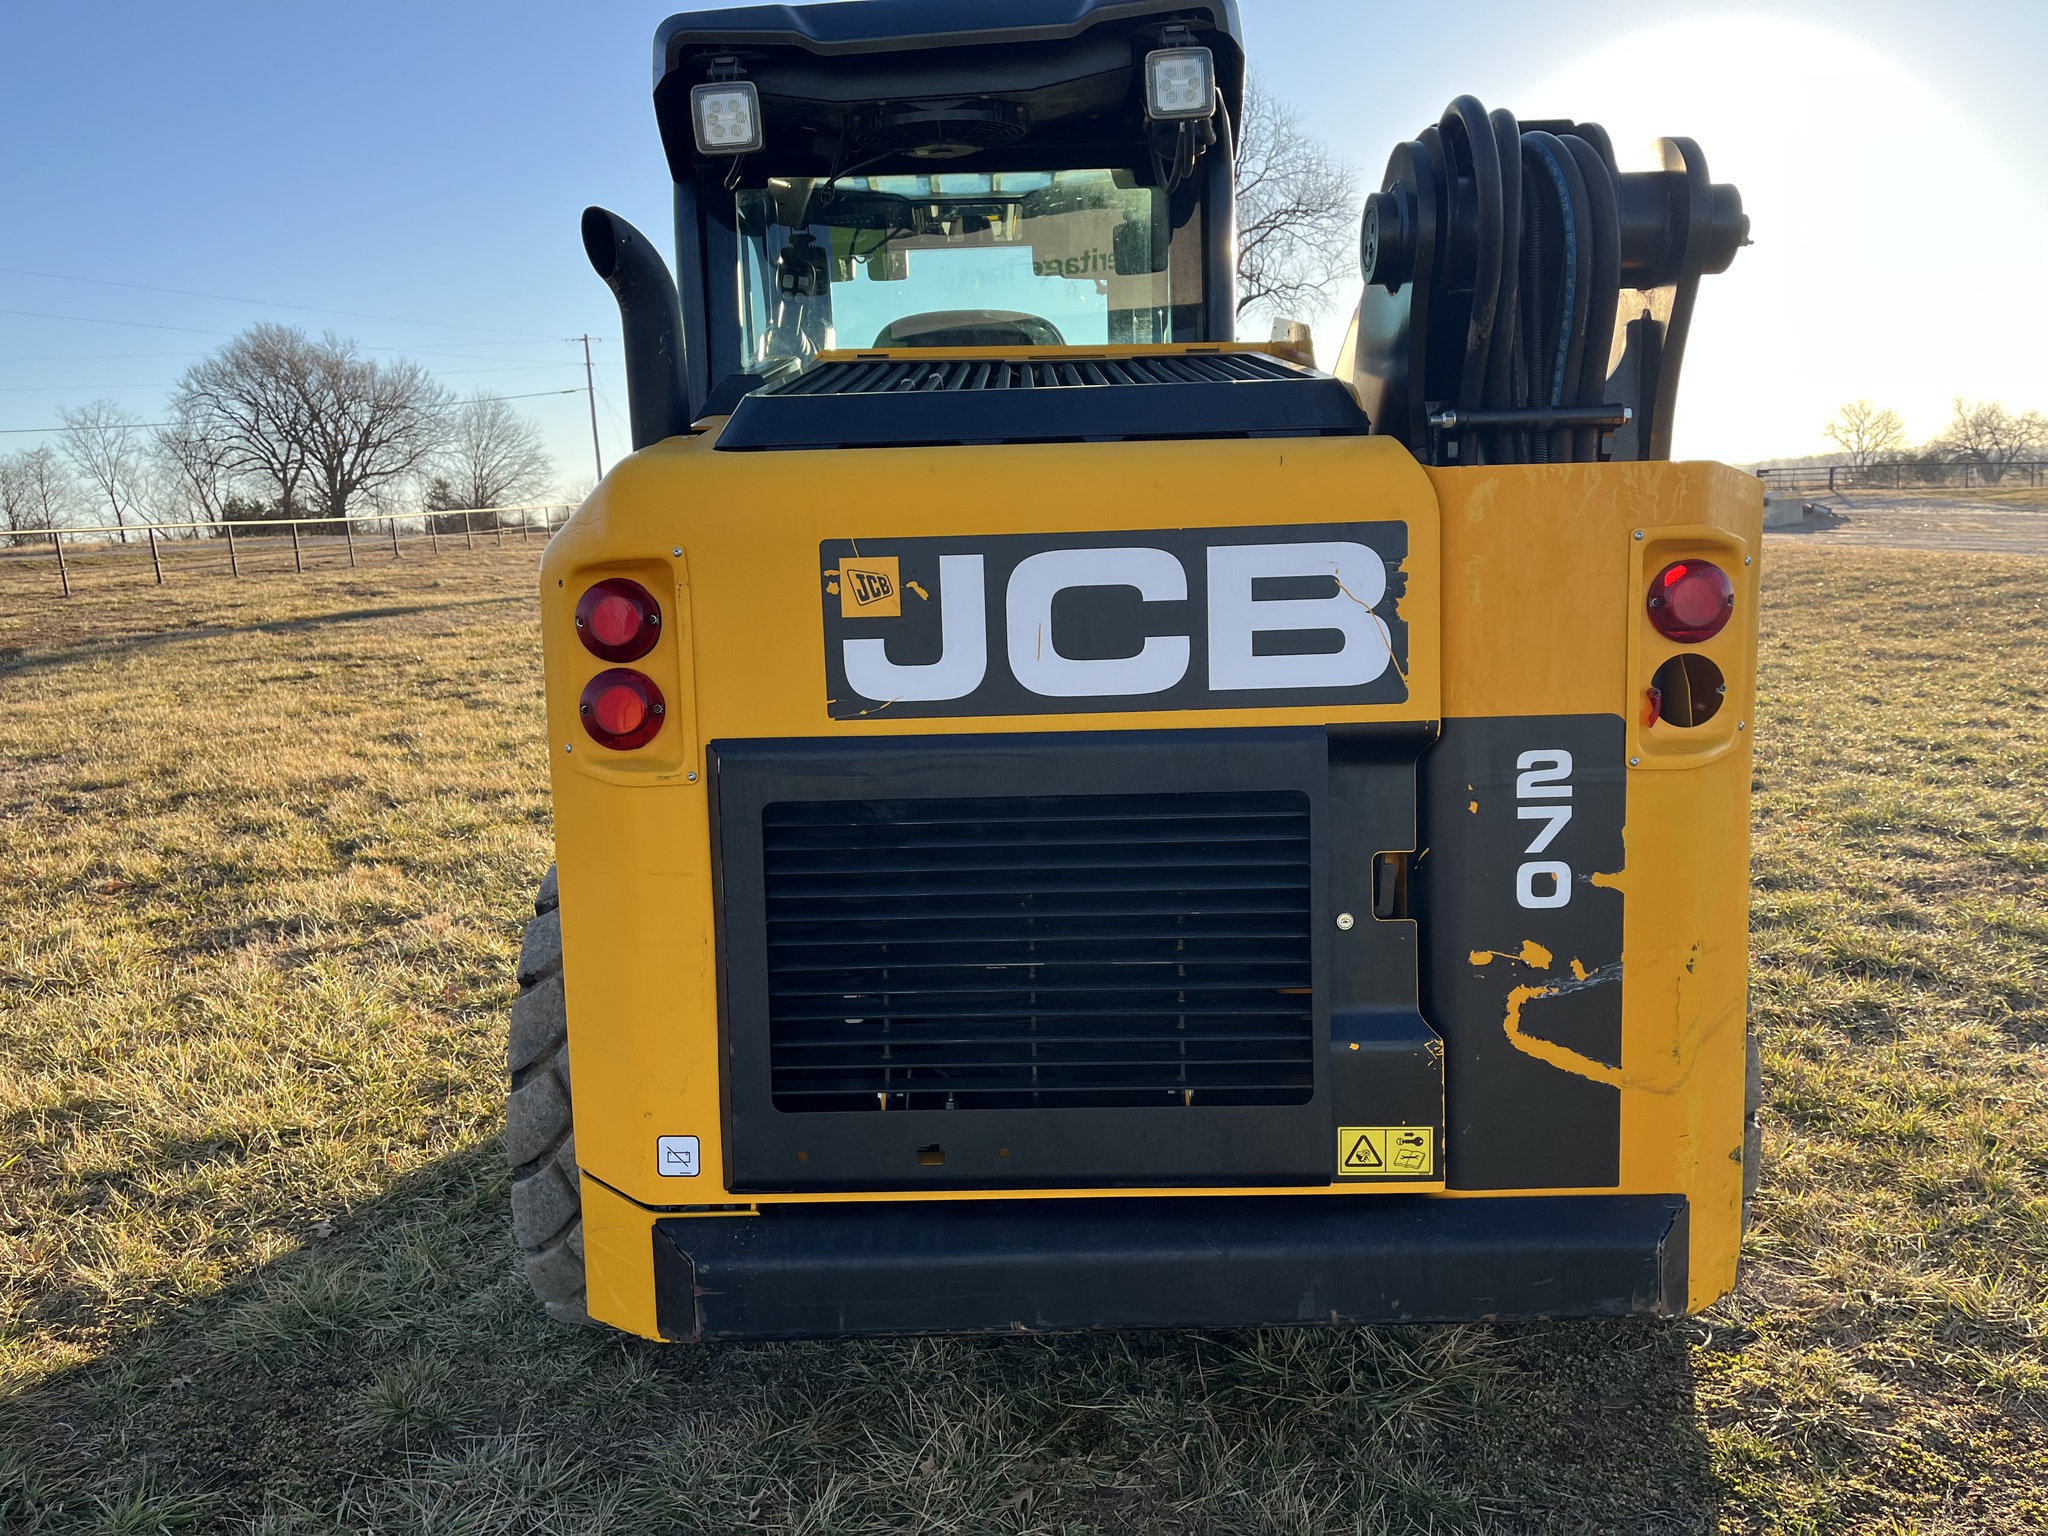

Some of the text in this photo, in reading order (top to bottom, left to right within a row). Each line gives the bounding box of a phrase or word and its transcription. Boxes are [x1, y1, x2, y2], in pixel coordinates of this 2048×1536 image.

[842, 541, 1392, 702] JCB
[855, 573, 890, 601] JCB
[1517, 750, 1573, 909] 270
